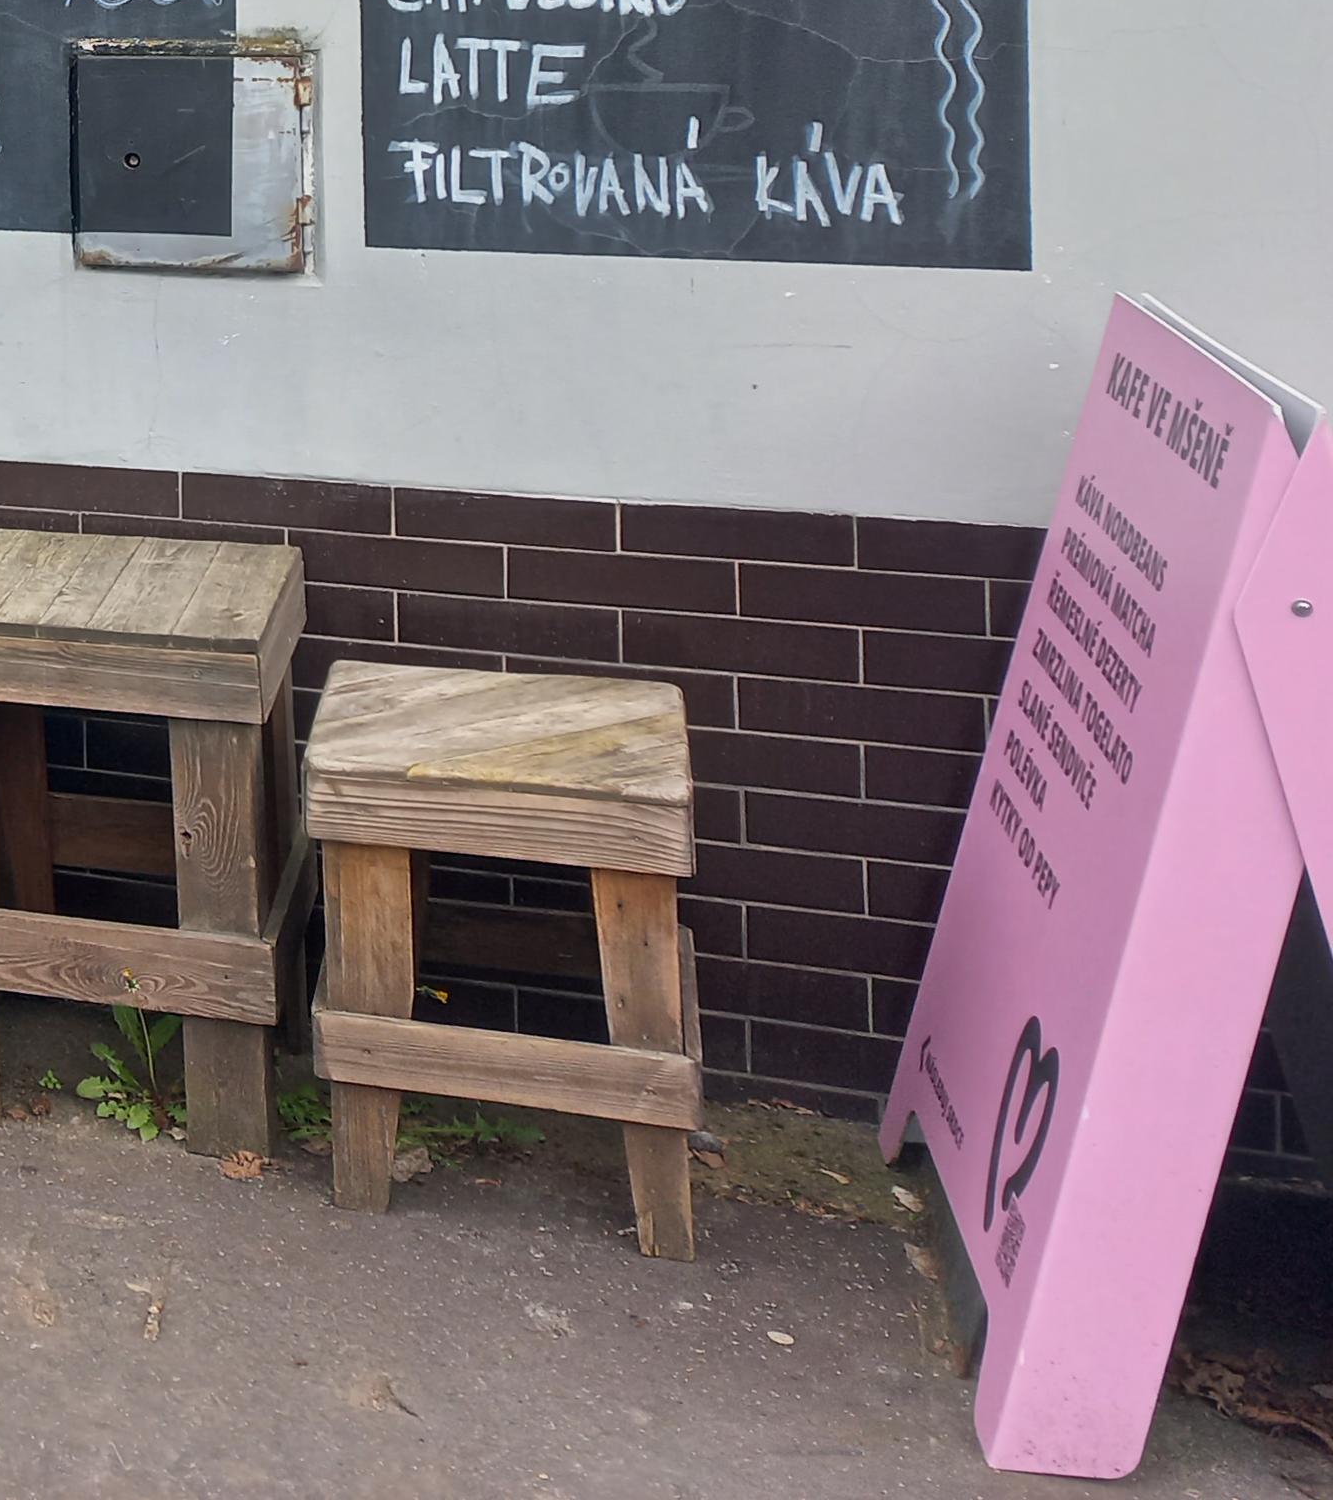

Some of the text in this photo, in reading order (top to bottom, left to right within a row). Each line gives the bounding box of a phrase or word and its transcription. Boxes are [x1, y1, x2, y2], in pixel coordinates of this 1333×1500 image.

[398, 33, 586, 105] LATTE
[388, 115, 906, 228] FILTROVANÁ KÁVA
[1105, 352, 1235, 489] KAFE VE MŠENĚ
[1060, 526, 1157, 659] PRÉMIOVÁ MATCHA
[1075, 474, 1168, 592] KÁVA NORDBEANS
[1032, 627, 1134, 786] ZMRZLINA TOGELATO
[1046, 569, 1143, 715] ŘEMESLNÉ DEZERTY
[1003, 729, 1048, 813] POLÉVKA
[1018, 679, 1097, 812] SLANÉ SENDVIČE
[989, 778, 1061, 911] KYTKY OD PEPY
